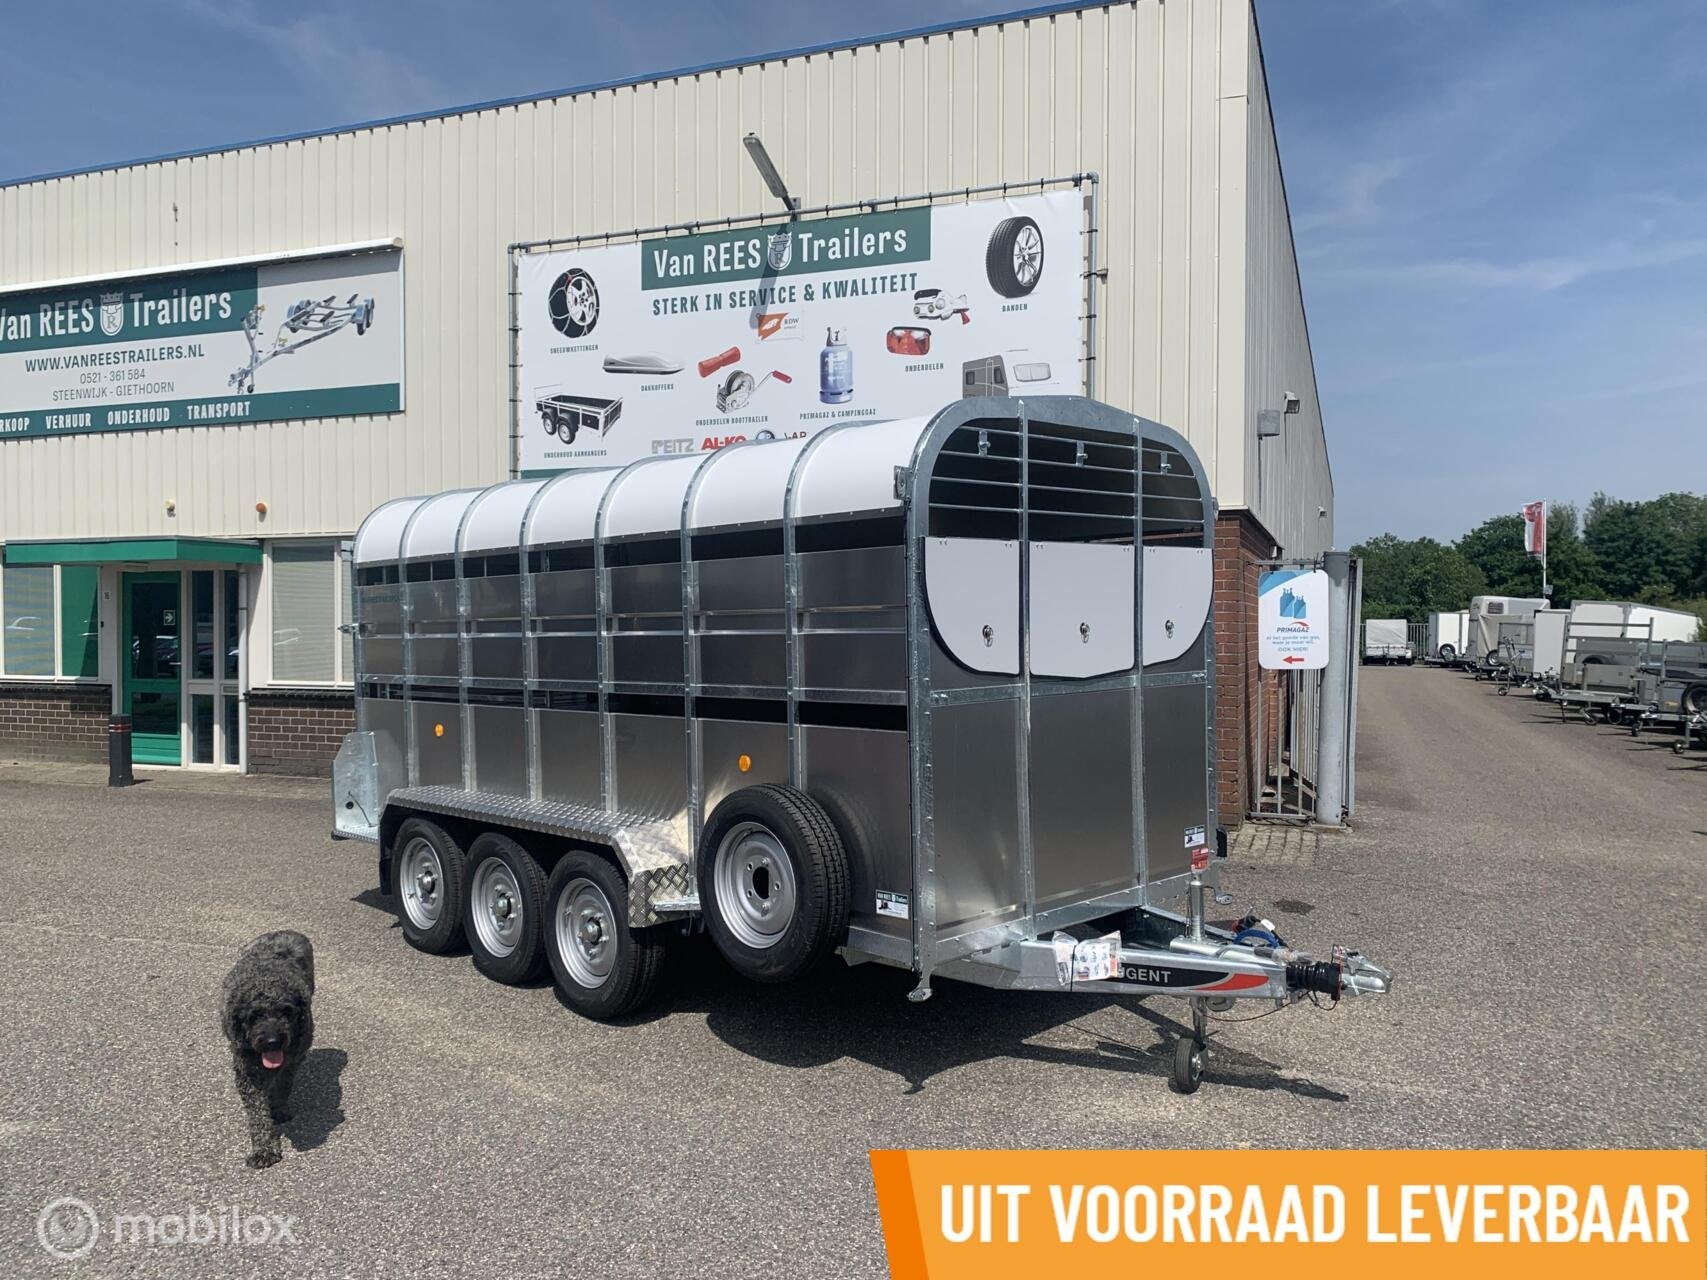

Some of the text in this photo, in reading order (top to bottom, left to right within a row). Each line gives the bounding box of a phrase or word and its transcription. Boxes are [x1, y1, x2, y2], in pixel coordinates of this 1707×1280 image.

[653, 249, 695, 278] Van
[703, 238, 761, 273] REES
[798, 227, 907, 263] Trailers
[652, 273, 918, 316] STERK IN SERVICE & KWALITEIT
[1002, 303, 1028, 312] BANDEN
[40, 299, 94, 337] REES
[129, 288, 232, 328] Trailers
[25, 343, 205, 372] WWW.VANREESTRAILERS.NL
[905, 362, 944, 372] ONDERDELEN
[79, 372, 101, 384] 0521
[109, 370, 125, 382] 361
[127, 368, 146, 380] 584
[52, 386, 108, 401] STEENWIJK
[115, 381, 175, 397] GIETHOORN
[45, 413, 92, 429] VERHUUR
[107, 407, 170, 426] ONDERHOUD
[187, 401, 251, 420] TRANSPORT
